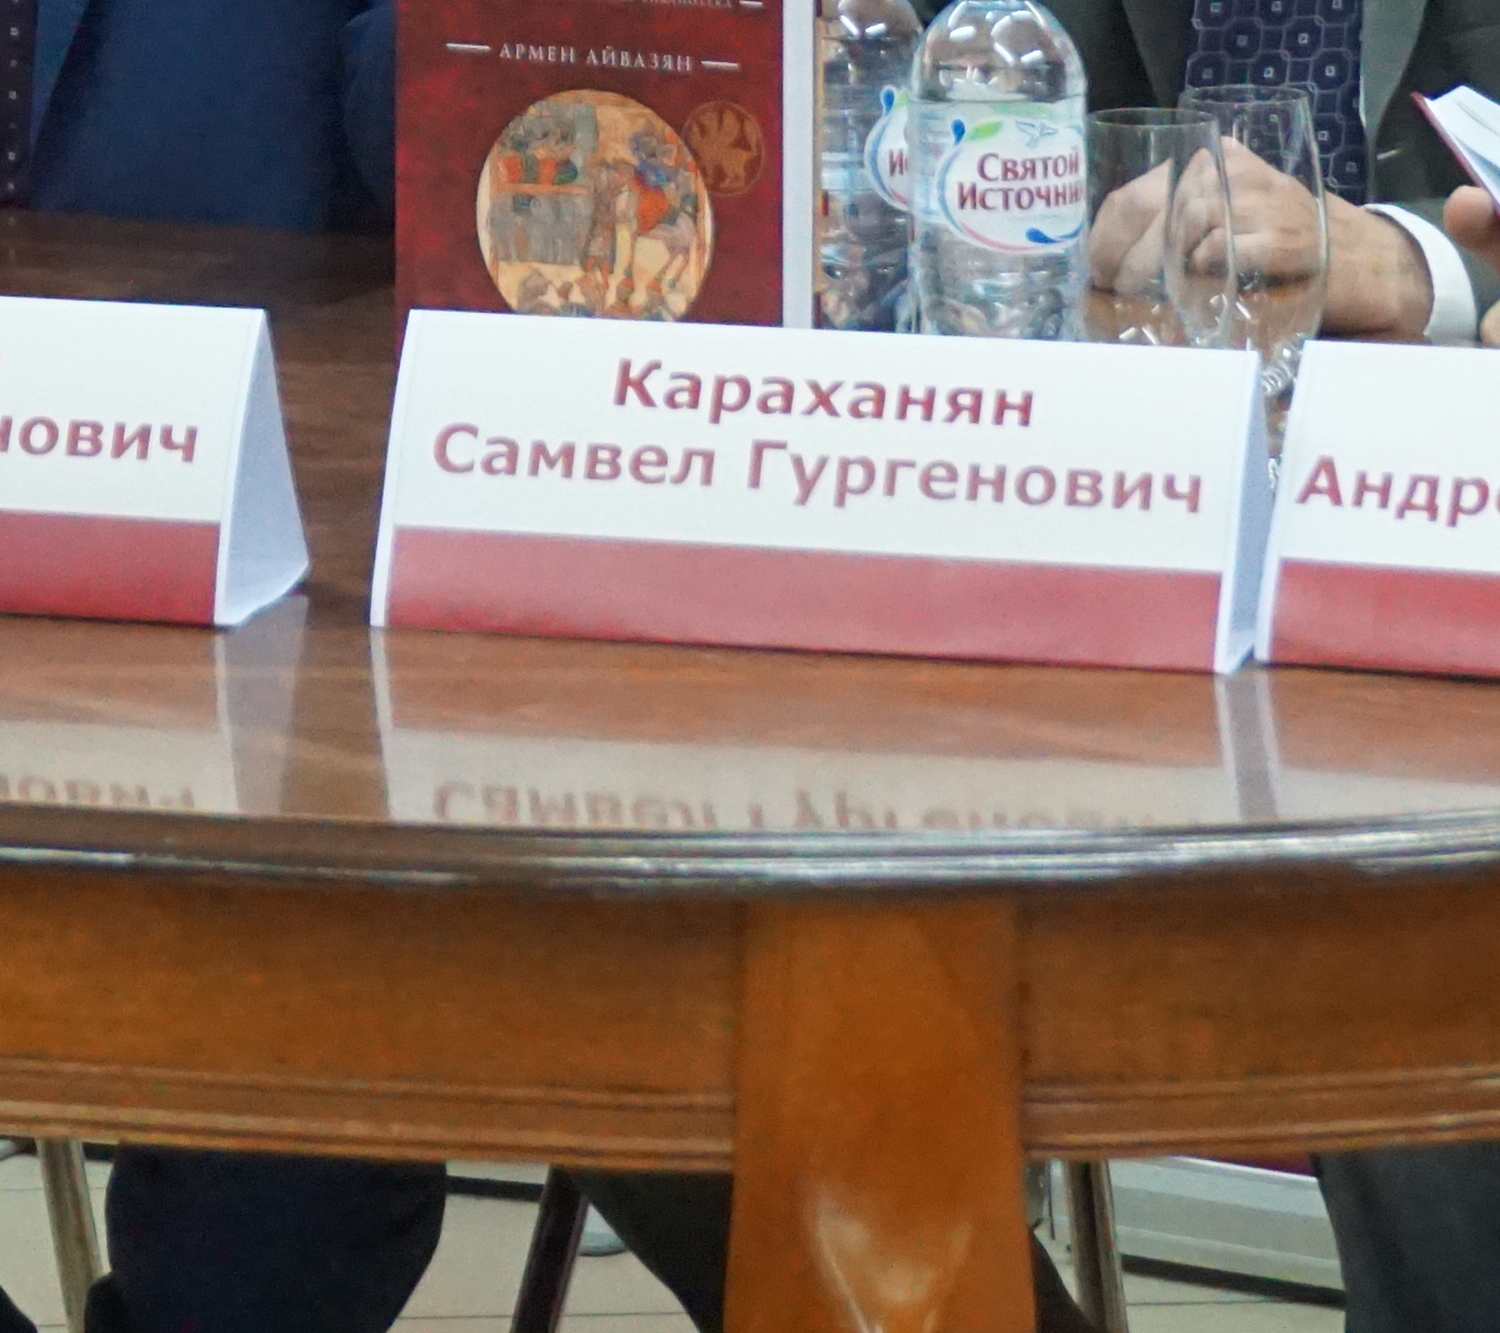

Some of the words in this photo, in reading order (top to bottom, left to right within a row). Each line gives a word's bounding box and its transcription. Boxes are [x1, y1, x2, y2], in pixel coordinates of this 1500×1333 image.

[499, 42, 576, 64] АРМЕН
[585, 45, 693, 73] АЙВАЗЯН
[614, 359, 1034, 427] Караханян
[435, 425, 715, 486] Самвел
[750, 441, 1202, 514] Гургенович
